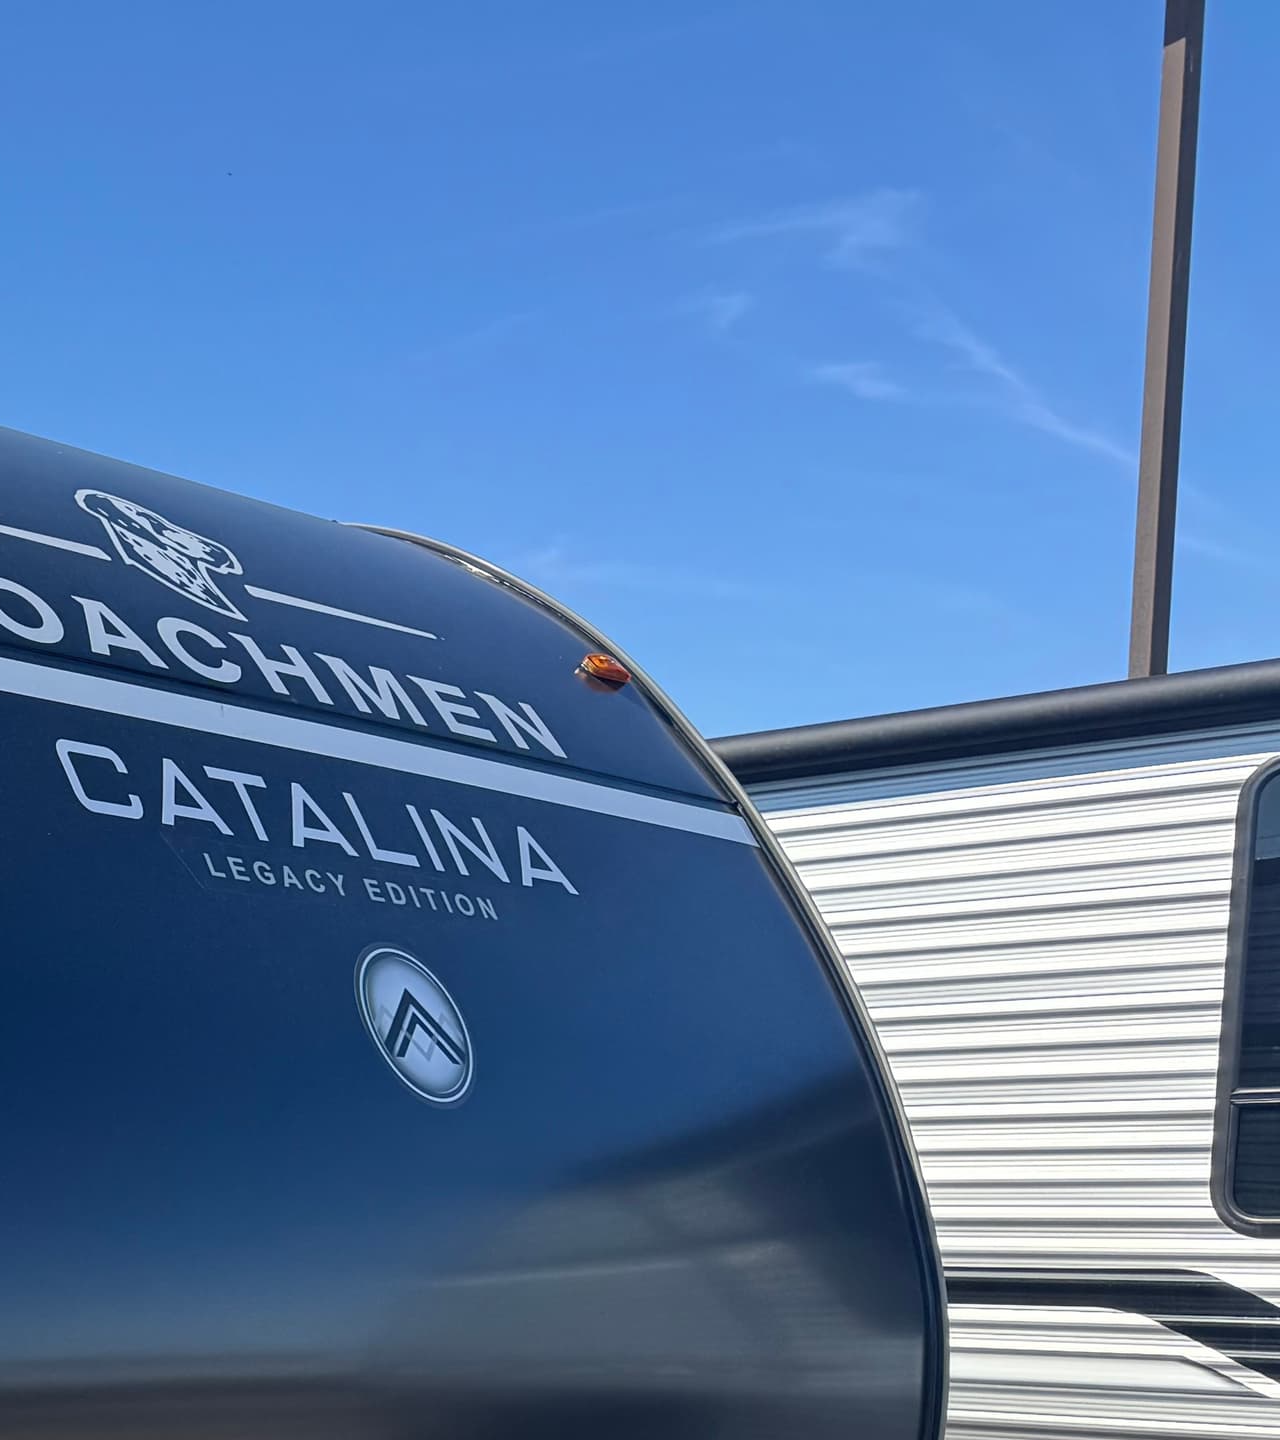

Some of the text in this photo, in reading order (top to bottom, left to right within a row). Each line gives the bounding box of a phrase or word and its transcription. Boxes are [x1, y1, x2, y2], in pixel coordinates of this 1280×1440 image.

[55, 738, 579, 896] CATALINA
[203, 852, 500, 921] LEGACY EDITION
